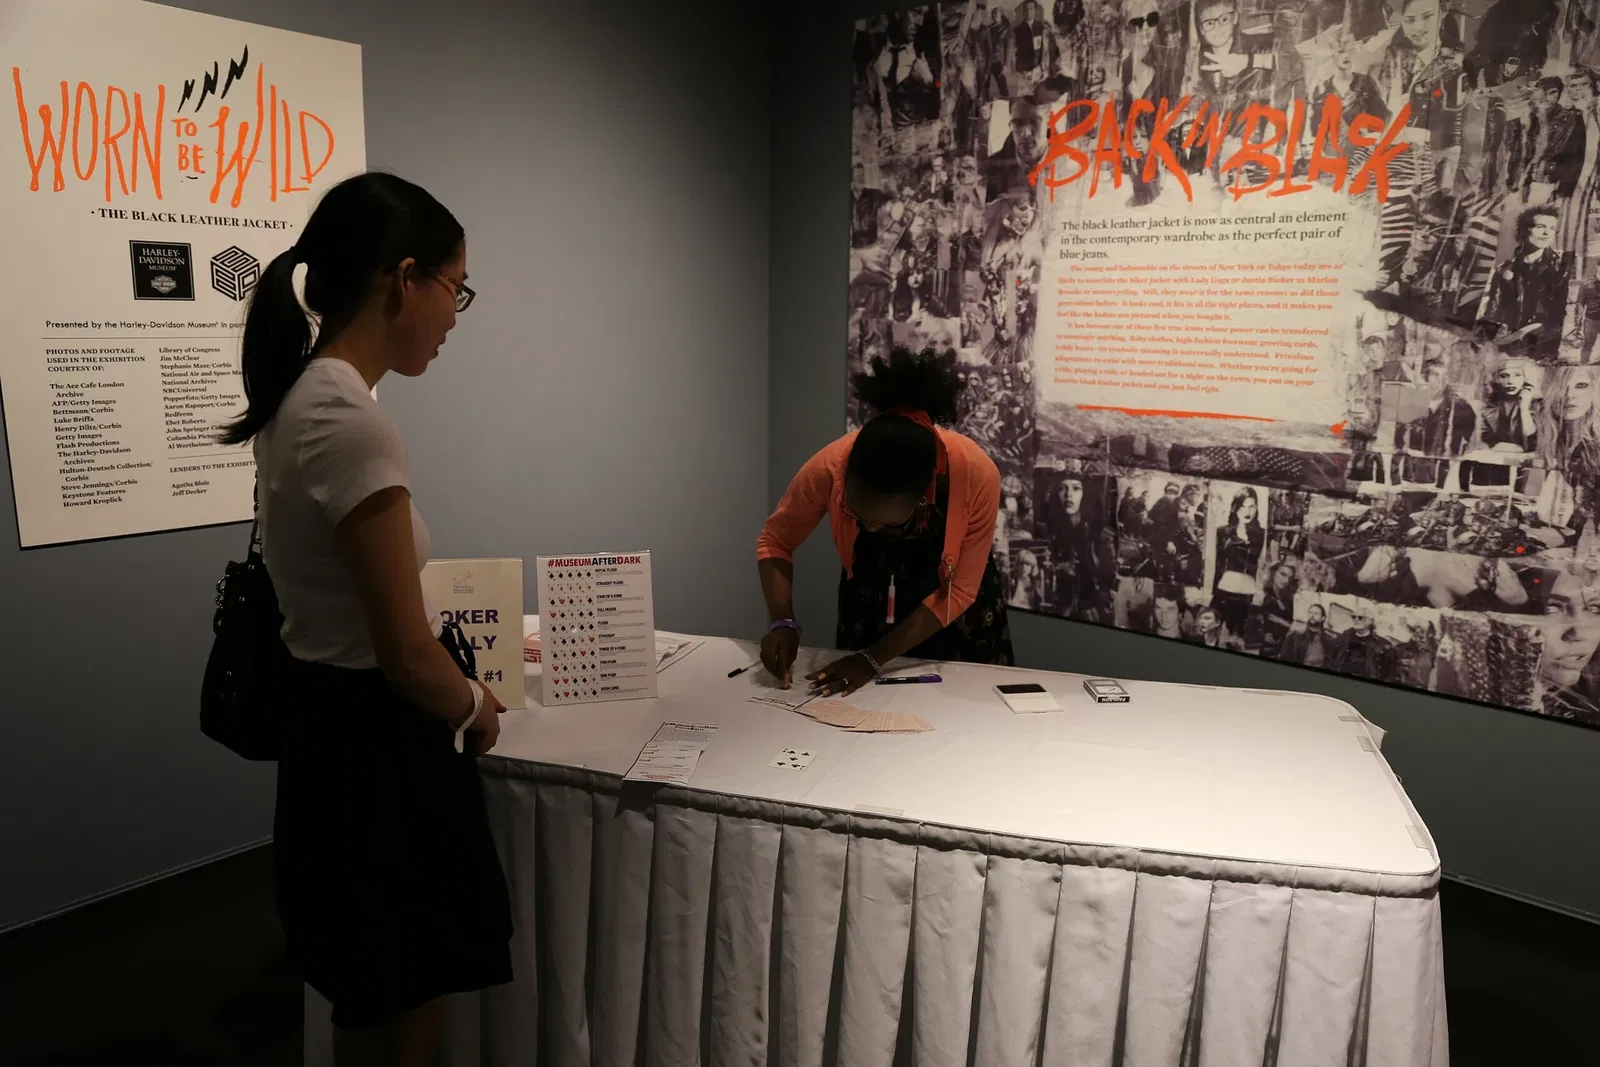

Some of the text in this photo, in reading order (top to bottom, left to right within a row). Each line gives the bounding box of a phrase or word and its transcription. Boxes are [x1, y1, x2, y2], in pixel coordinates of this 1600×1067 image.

[12, 62, 335, 208] WORN TO BE WILD
[1028, 91, 1412, 204] BACK IN BLACK
[98, 208, 288, 230] THE BLACK LEATHER JACKET
[1062, 212, 1347, 230] The black leather jacket is now as central an element
[1060, 226, 1344, 245] in the contemporary wardrobe as the perfect pair of
[142, 248, 180, 257] HARLEY-
[1060, 249, 1110, 260] blue jeans.
[138, 256, 185, 265] DAVIDSON
[46, 320, 88, 328] Presented
[91, 321, 102, 330] by
[120, 320, 185, 330] Harley-Davidson
[164, 394, 218, 402] Popperfoto/Getty
[184, 401, 236, 410] Rapoport/Corbis
[52, 406, 114, 416] Bettmann/Corbis
[79, 422, 122, 431] Diltz/Corbis
[183, 426, 210, 434] Springer
[78, 440, 120, 448] Productions
[73, 448, 132, 457] Harley-Davidson
[63, 458, 95, 466] Archives
[60, 464, 116, 474] Hulton-Deutsch
[82, 479, 138, 489] Jennings/Corbis
[62, 490, 96, 500] Keystone
[63, 496, 122, 508] Howard Kroplick
[440, 610, 499, 624] OKER
[484, 670, 504, 682] #1
